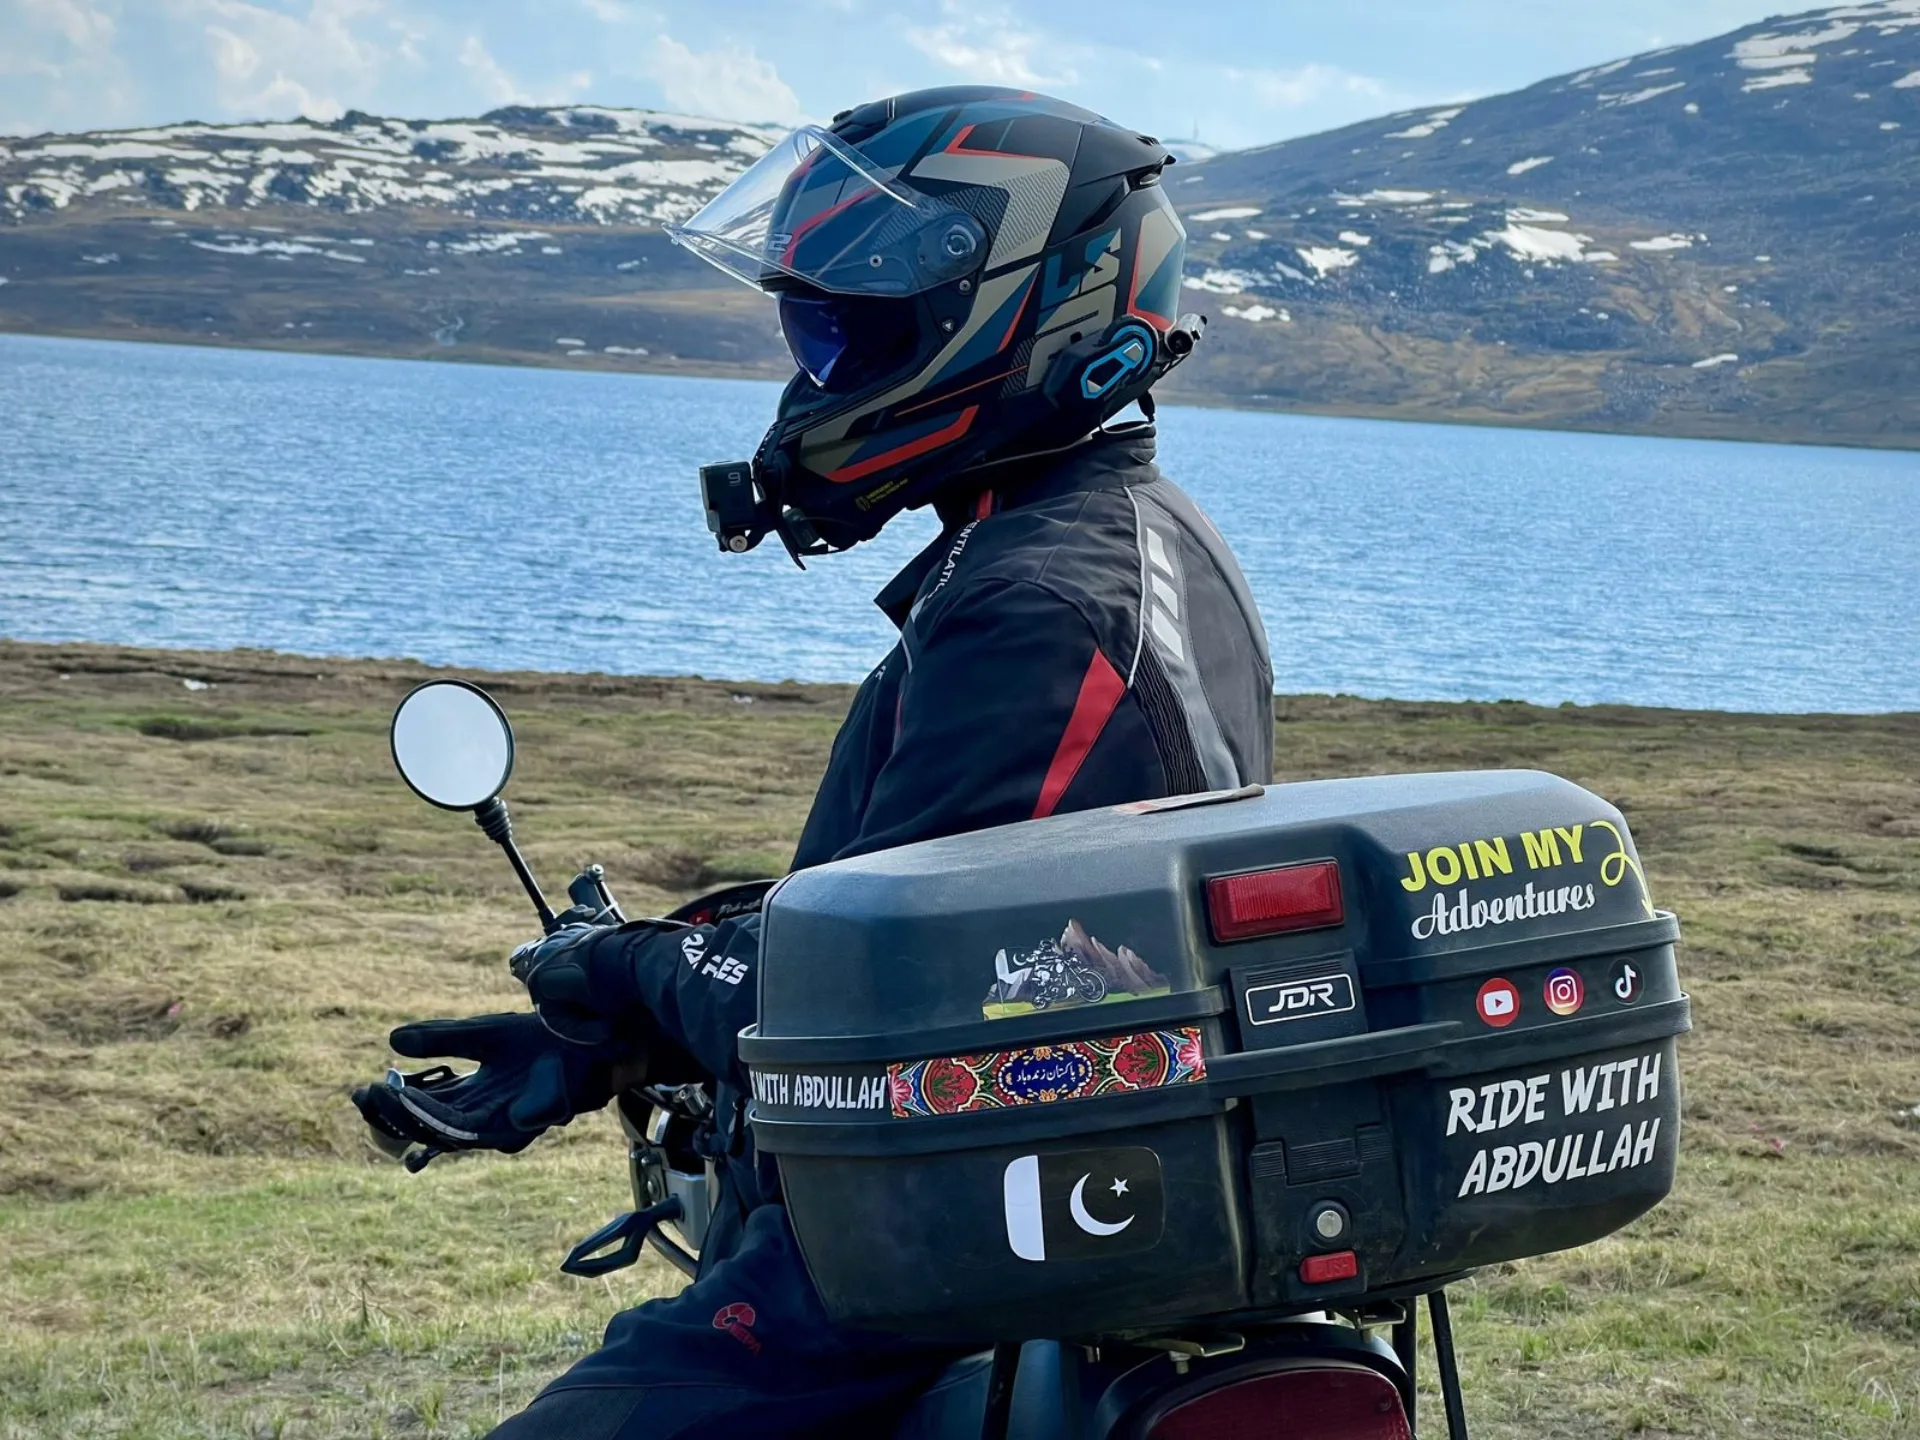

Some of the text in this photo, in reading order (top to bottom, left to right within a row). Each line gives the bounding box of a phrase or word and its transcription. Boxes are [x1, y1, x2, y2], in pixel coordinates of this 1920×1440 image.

[1401, 825, 1583, 892] JOIN MY
[1411, 881, 1595, 940] Adventures
[1268, 983, 1336, 1013] JDR
[755, 1071, 788, 1105] WITH
[794, 1074, 887, 1110] ABDULLAH
[1046, 1061, 1076, 1083] پاکستان
[1446, 1052, 1662, 1136] RIDE WITH
[1457, 1117, 1661, 1198] ABDULLAH
